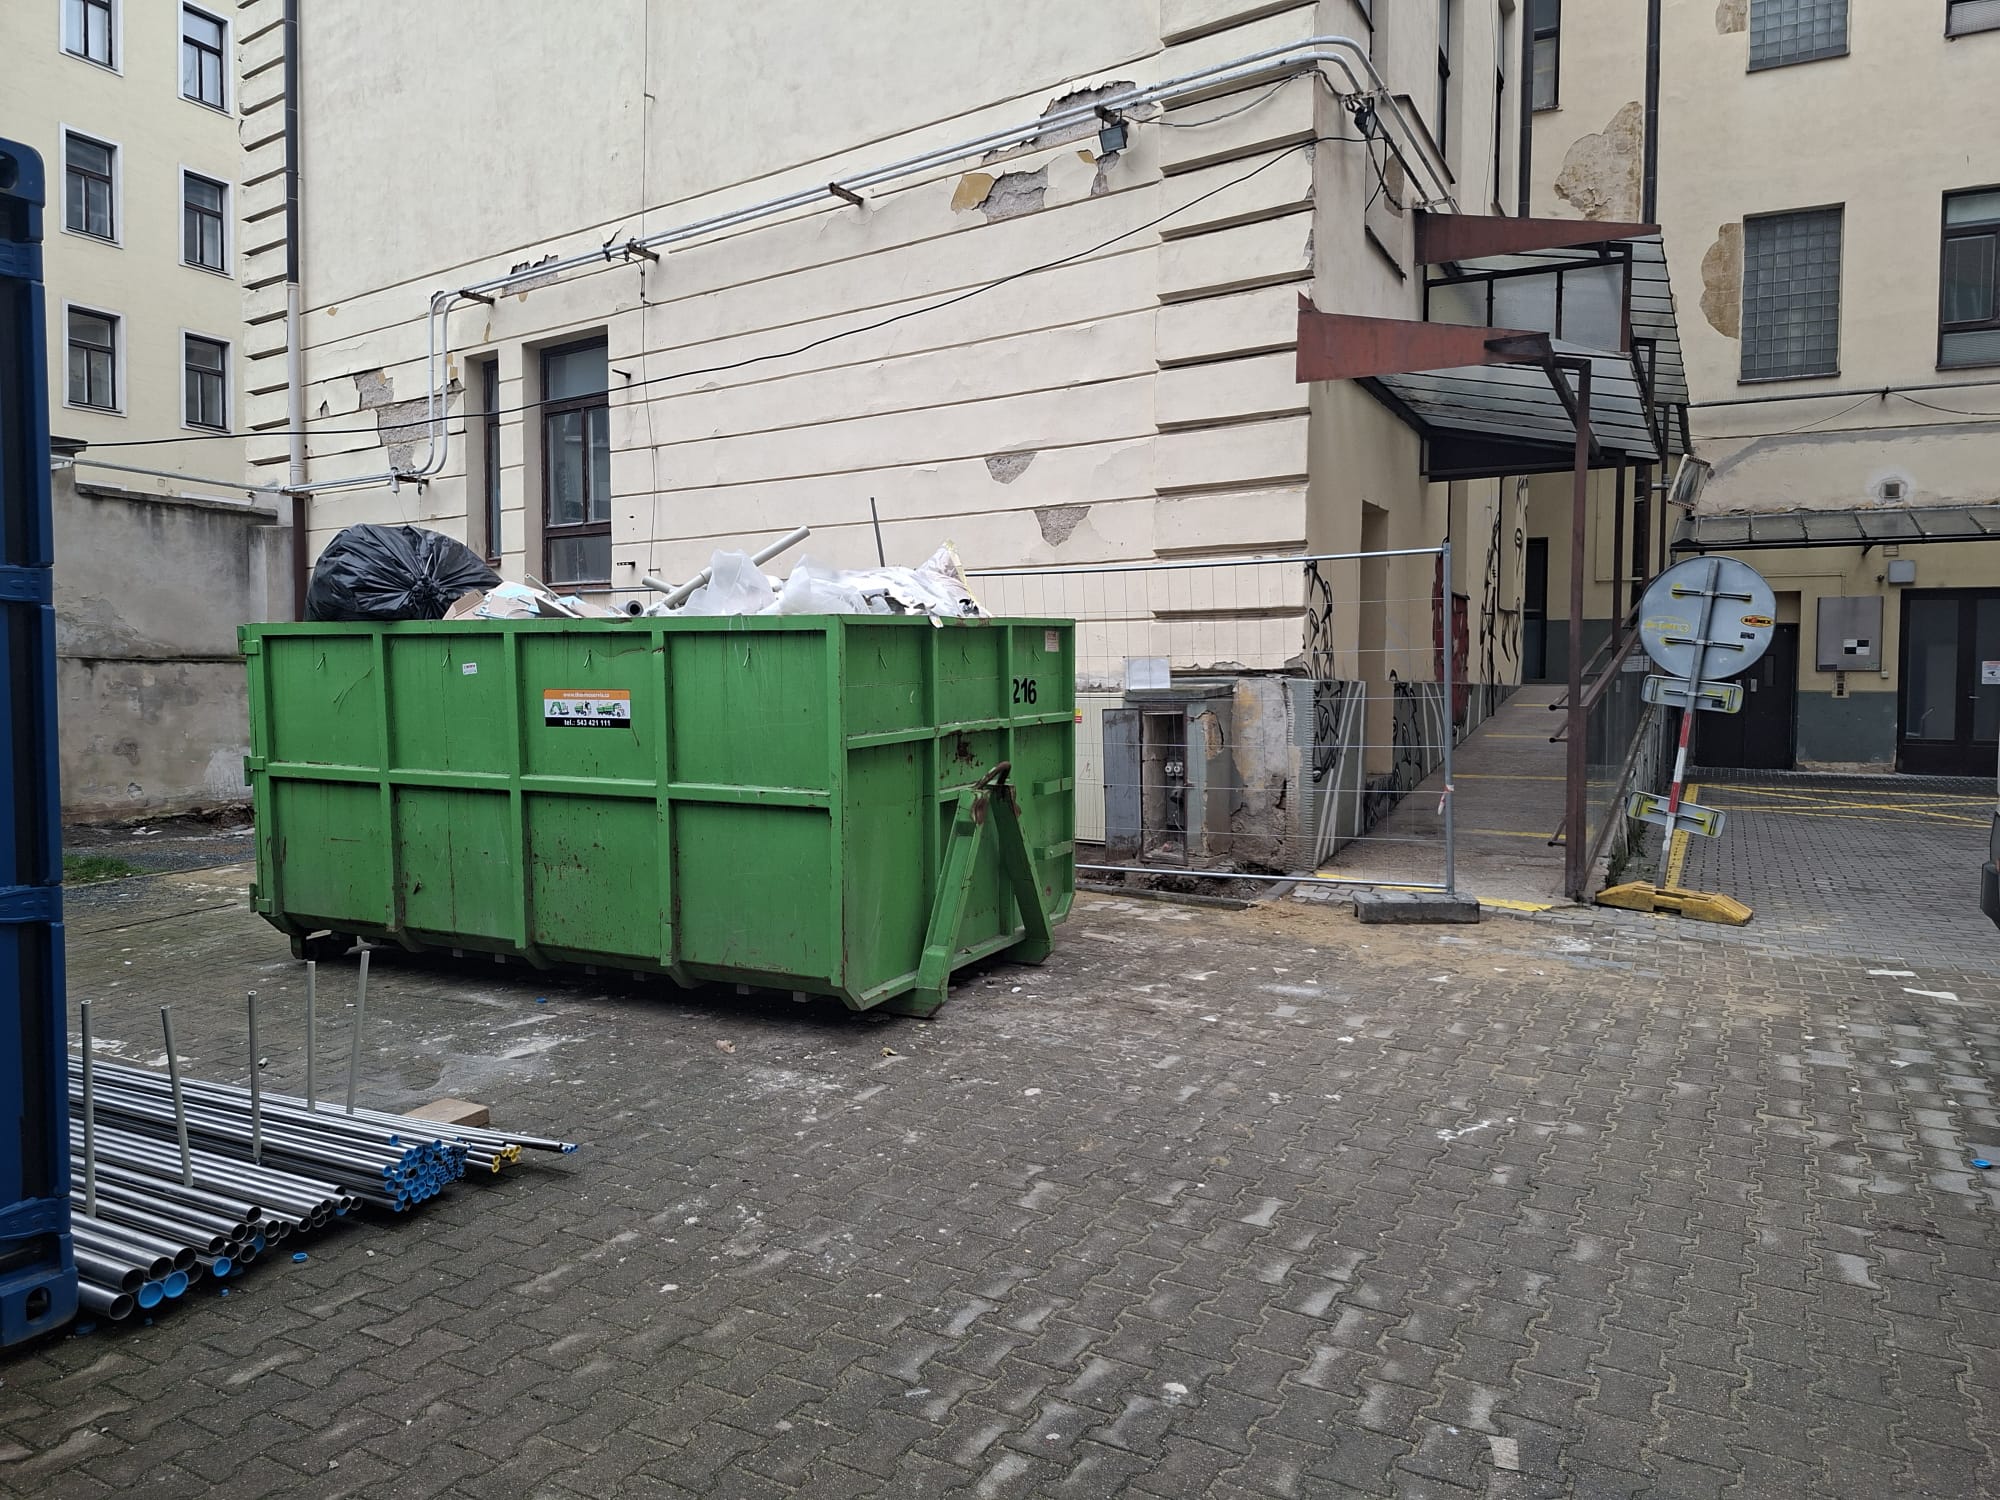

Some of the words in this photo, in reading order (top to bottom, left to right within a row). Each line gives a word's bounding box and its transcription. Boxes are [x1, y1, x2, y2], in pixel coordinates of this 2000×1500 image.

[1013, 678, 1037, 704] 216
[588, 719, 599, 727] 421
[600, 719, 611, 727] 111
